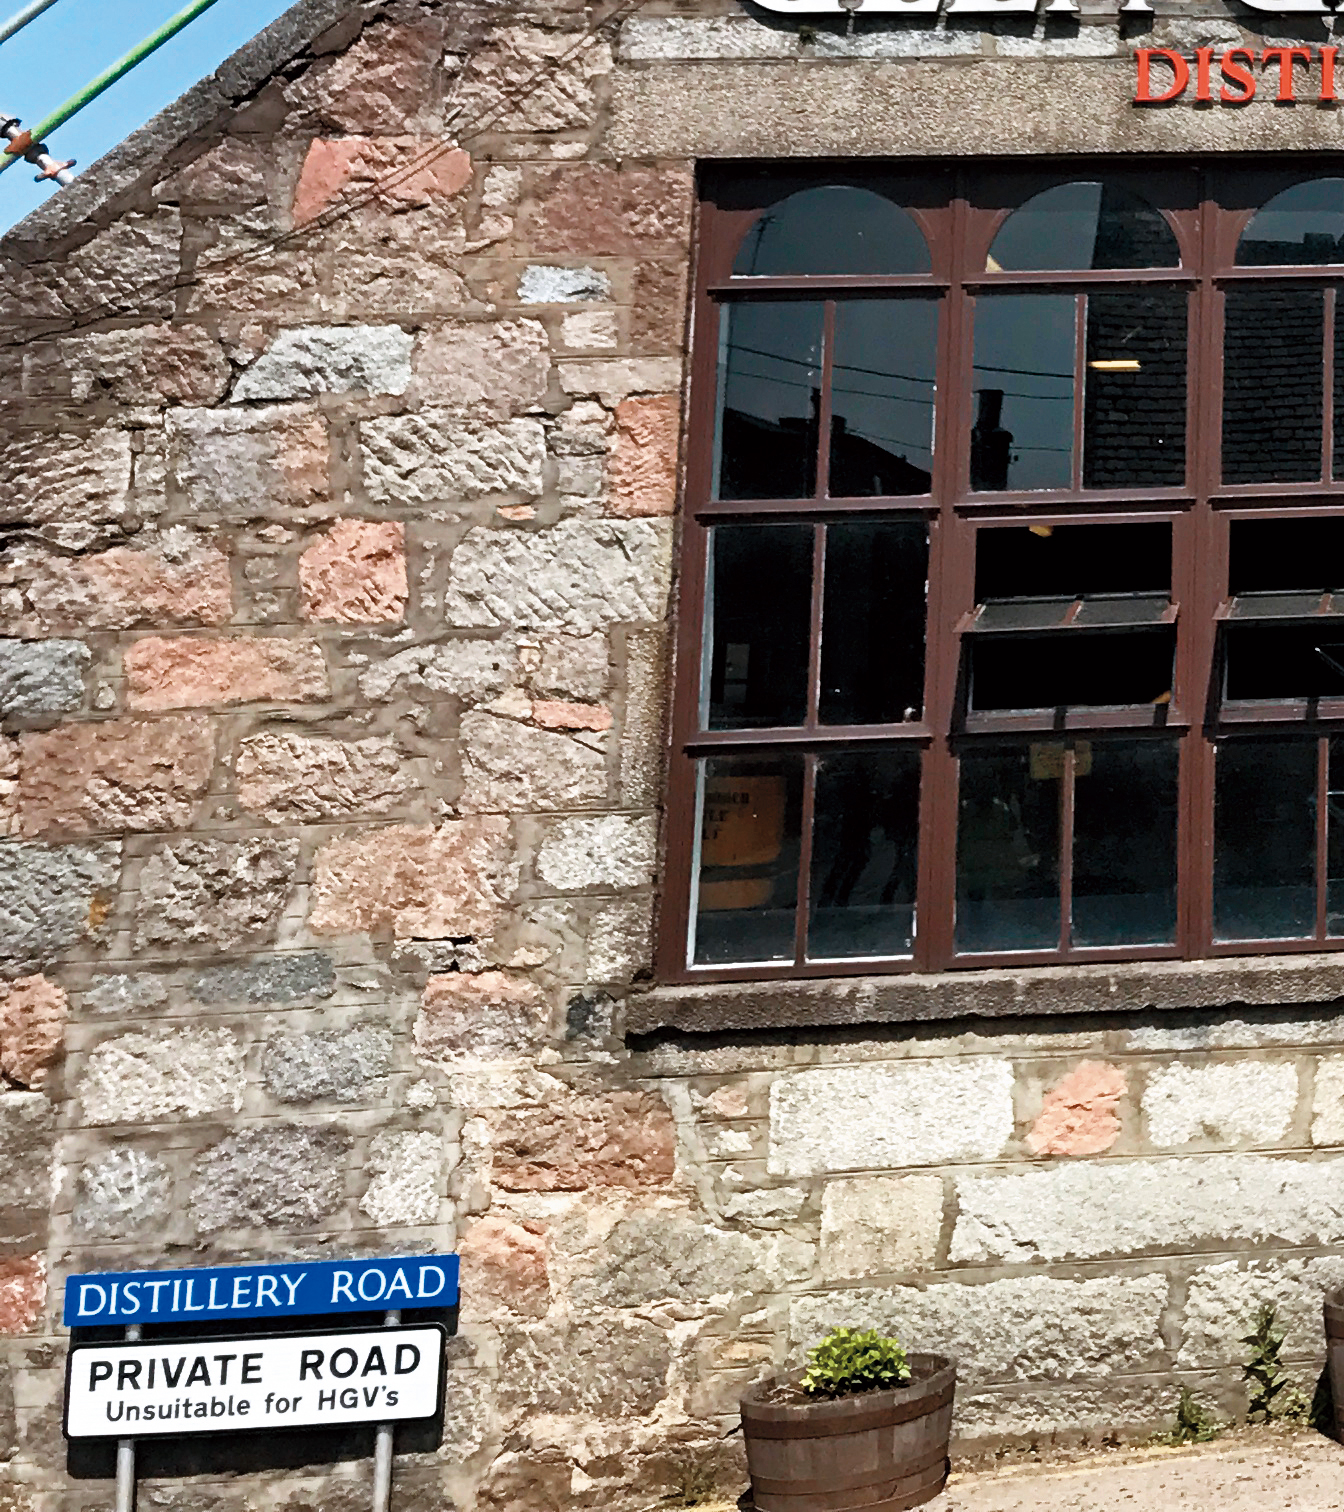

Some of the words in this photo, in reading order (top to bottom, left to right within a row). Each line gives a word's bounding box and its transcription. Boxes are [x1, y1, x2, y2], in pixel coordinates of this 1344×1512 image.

[77, 1273, 307, 1316] DISTILLERY
[330, 1265, 446, 1304] ROAD
[89, 1352, 263, 1391] PRIVATE
[299, 1343, 422, 1382] ROAD
[105, 1396, 251, 1422] Unsuitable
[264, 1392, 301, 1414] for
[318, 1385, 400, 1410] HGV's
